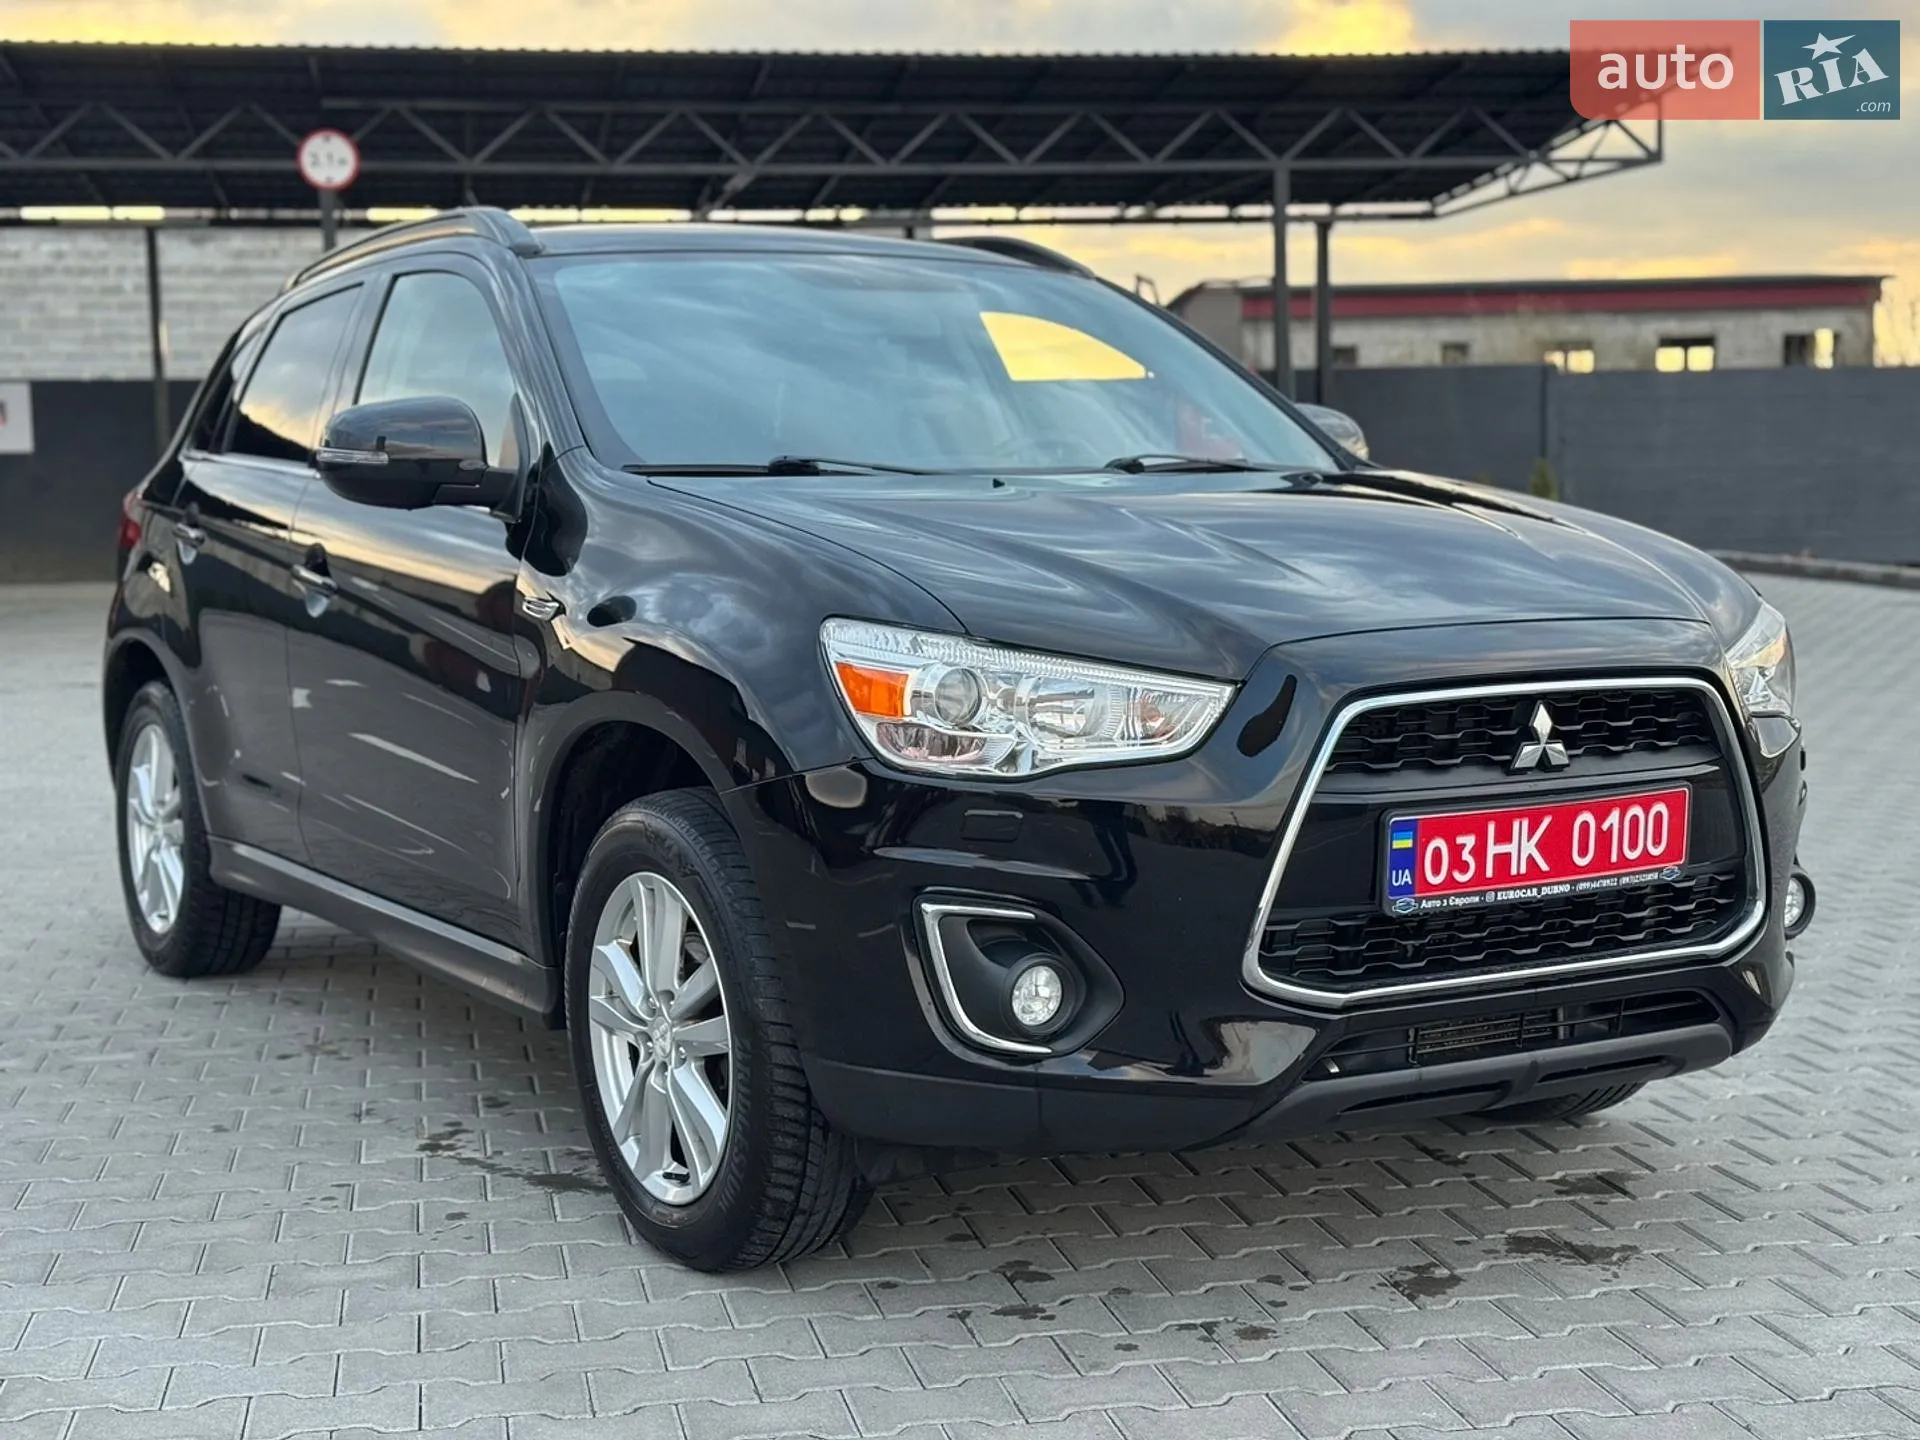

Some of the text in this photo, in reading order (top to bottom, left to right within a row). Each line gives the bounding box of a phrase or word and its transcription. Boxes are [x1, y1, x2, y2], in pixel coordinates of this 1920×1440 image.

[1424, 801, 1669, 886] 03 HK 0100
[1391, 870, 1412, 887] UA
[1420, 899, 1441, 909] Авто
